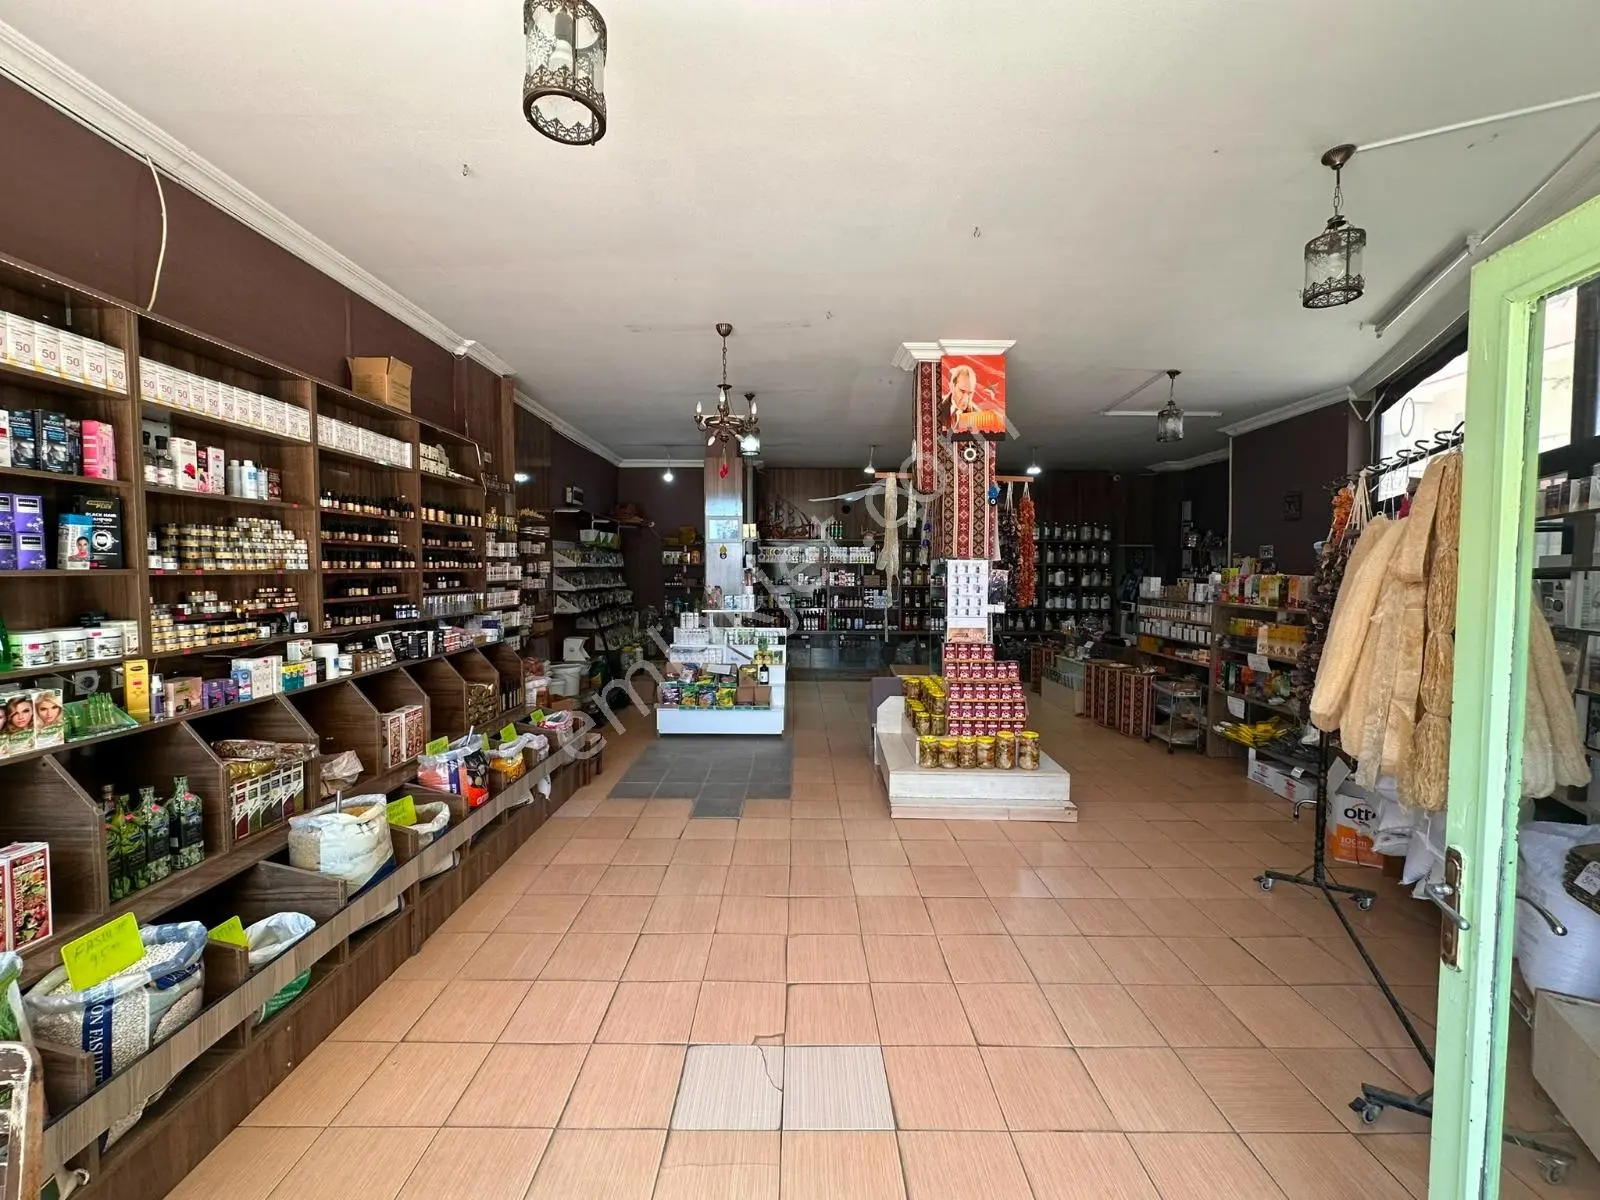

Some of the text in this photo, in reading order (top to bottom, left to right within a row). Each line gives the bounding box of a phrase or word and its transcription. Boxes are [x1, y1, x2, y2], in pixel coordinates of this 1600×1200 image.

[16, 341, 30, 353] 50
[42, 349, 56, 360] 50
[66, 356, 80, 367] 50
[89, 363, 103, 373] 50
[112, 369, 124, 379] 50
[143, 380, 154, 390] 50
[161, 385, 172, 395] 50
[177, 389, 188, 399] 50
[209, 399, 218, 408] 50
